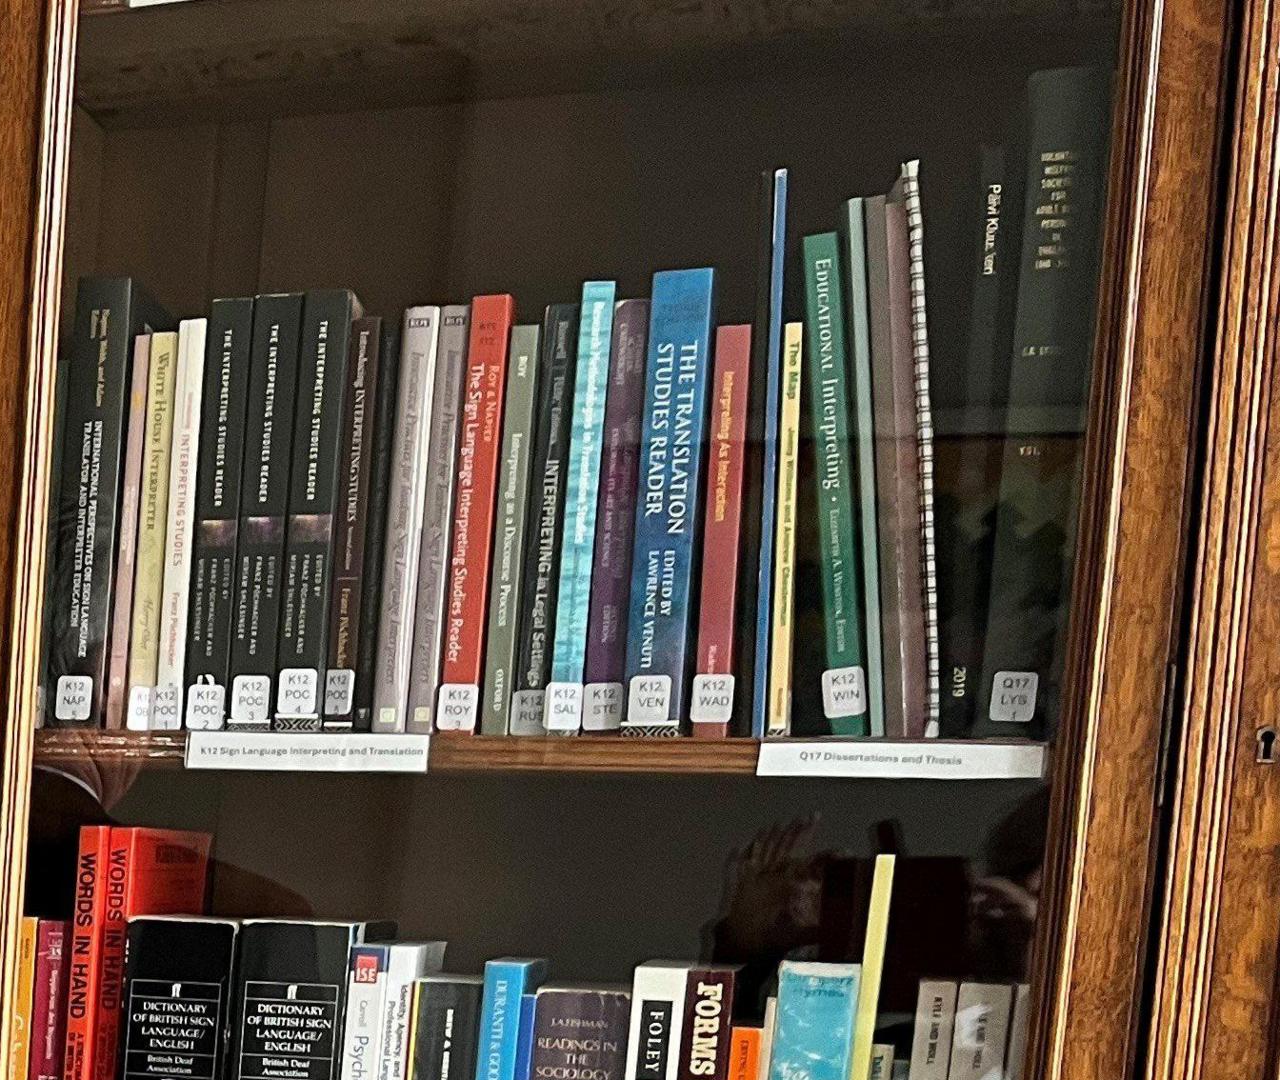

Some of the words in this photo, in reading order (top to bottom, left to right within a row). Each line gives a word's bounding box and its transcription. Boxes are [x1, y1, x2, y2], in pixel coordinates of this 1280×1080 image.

[318, 319, 329, 340] THE
[815, 258, 834, 373] EDUCATIONAL
[223, 329, 233, 349] THE
[269, 323, 280, 344] THE
[312, 342, 327, 416] INTERPRETING
[471, 362, 485, 389] The
[678, 340, 699, 386] THE
[218, 351, 232, 423] INTERPRETING
[264, 347, 278, 418] INTERPRETING
[652, 343, 675, 432] STUDIES
[465, 389, 484, 421] Sign
[215, 425, 227, 467] STUDIES
[261, 420, 273, 463] STUDIES
[309, 417, 321, 460] STUDIES
[819, 377, 842, 490] Interpreting
[459, 422, 480, 486] Language
[666, 387, 696, 536] TRANSLATION
[175, 433, 190, 514] INTERPRETING
[214, 469, 225, 507] READER
[258, 464, 270, 503] READER
[306, 462, 318, 501] READER
[645, 436, 668, 518] READER
[452, 488, 473, 567] Interpreting
[537, 458, 560, 573] INTERPRETING
[172, 520, 184, 567] STUDIES
[450, 567, 468, 616] Studies
[643, 550, 661, 618] LAWRENCE
[660, 550, 676, 600] EDITED
[531, 592, 548, 629] Legal
[448, 617, 464, 663] Reader
[526, 630, 545, 688] Settings
[285, 690, 310, 700] POC
[832, 690, 860, 701] WIN
[952, 666, 966, 697] 2019
[62, 696, 85, 705] NAP
[153, 706, 177, 716] POC
[193, 706, 218, 715] POC
[444, 706, 471, 716] ROY
[553, 706, 577, 716] SAL
[637, 697, 665, 708] VEN
[699, 696, 730, 706] WAD
[220, 747, 241, 758] Sign
[242, 747, 288, 757] Language
[289, 747, 347, 757] Interpreting
[348, 747, 367, 756] and
[369, 747, 424, 757] Translation
[799, 751, 822, 761] Q17
[823, 752, 899, 764] Dissertations
[901, 755, 922, 764] and
[925, 755, 963, 765] Thesis
[76, 852, 97, 928] WORDS
[106, 848, 128, 924] WORDS
[74, 934, 92, 957] IN
[69, 961, 90, 1020] HAND
[142, 1000, 208, 1014] DICTIONARY
[132, 1013, 148, 1023] OF
[149, 1013, 188, 1026] BRITISH
[189, 1015, 215, 1027] SIGN
[247, 1015, 263, 1026] OF
[264, 1016, 305, 1028] BRITISH
[306, 1017, 332, 1030] SIGN
[257, 1003, 325, 1016] DICTIONARY
[141, 1026, 206, 1040] LANGUAGE/
[149, 1038, 195, 1051] ENGLISH
[255, 1029, 323, 1042] LANGUAGE/
[537, 1037, 601, 1051] READINGS
[643, 1010, 665, 1073] FOLEY
[689, 981, 724, 1076] FORMS
[262, 1057, 289, 1068] British
[290, 1059, 310, 1069] Deaf
[264, 1041, 311, 1053] ENGLISH
[565, 1052, 588, 1066] THE
[146, 1064, 193, 1075] Association
[262, 1068, 309, 1078] Association
